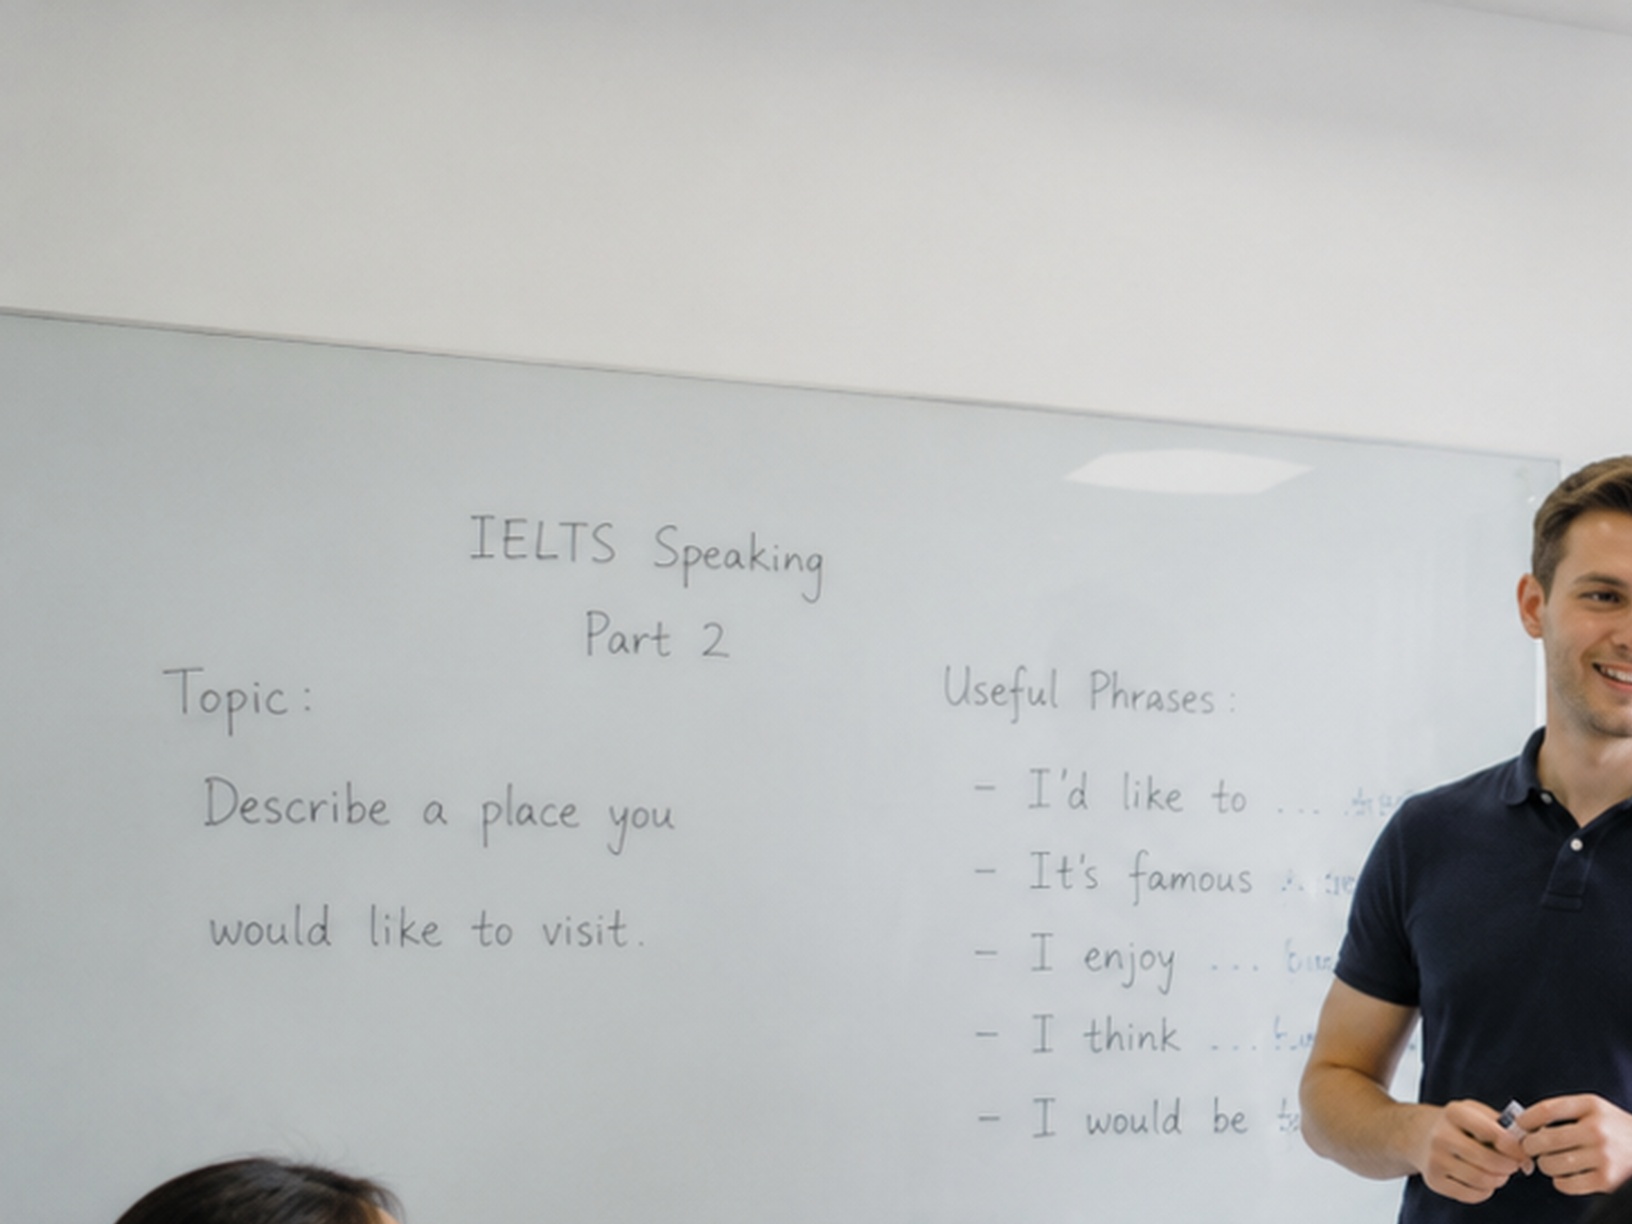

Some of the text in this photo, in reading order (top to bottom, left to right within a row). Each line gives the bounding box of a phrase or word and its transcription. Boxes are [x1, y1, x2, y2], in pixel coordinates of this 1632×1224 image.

[468, 513, 825, 605] IELTS Speaking
[584, 608, 731, 660] Part 2
[160, 665, 312, 739] Topic:
[943, 663, 1236, 726] Useful Phrases:
[202, 775, 676, 858] Describe a place you
[1027, 766, 1090, 811] I'd
[1122, 770, 1185, 814] like
[1209, 777, 1248, 816] to
[1028, 849, 1100, 891] It's
[1127, 848, 1254, 908] famous
[208, 902, 645, 949] would like to visit.
[1029, 931, 1055, 973] I
[1082, 941, 1176, 997] enjoy
[1031, 1012, 1056, 1055] I
[1082, 1014, 1182, 1055] think
[1031, 1096, 1057, 1140] I
[1085, 1096, 1183, 1137] would
[1212, 1095, 1249, 1136] be
